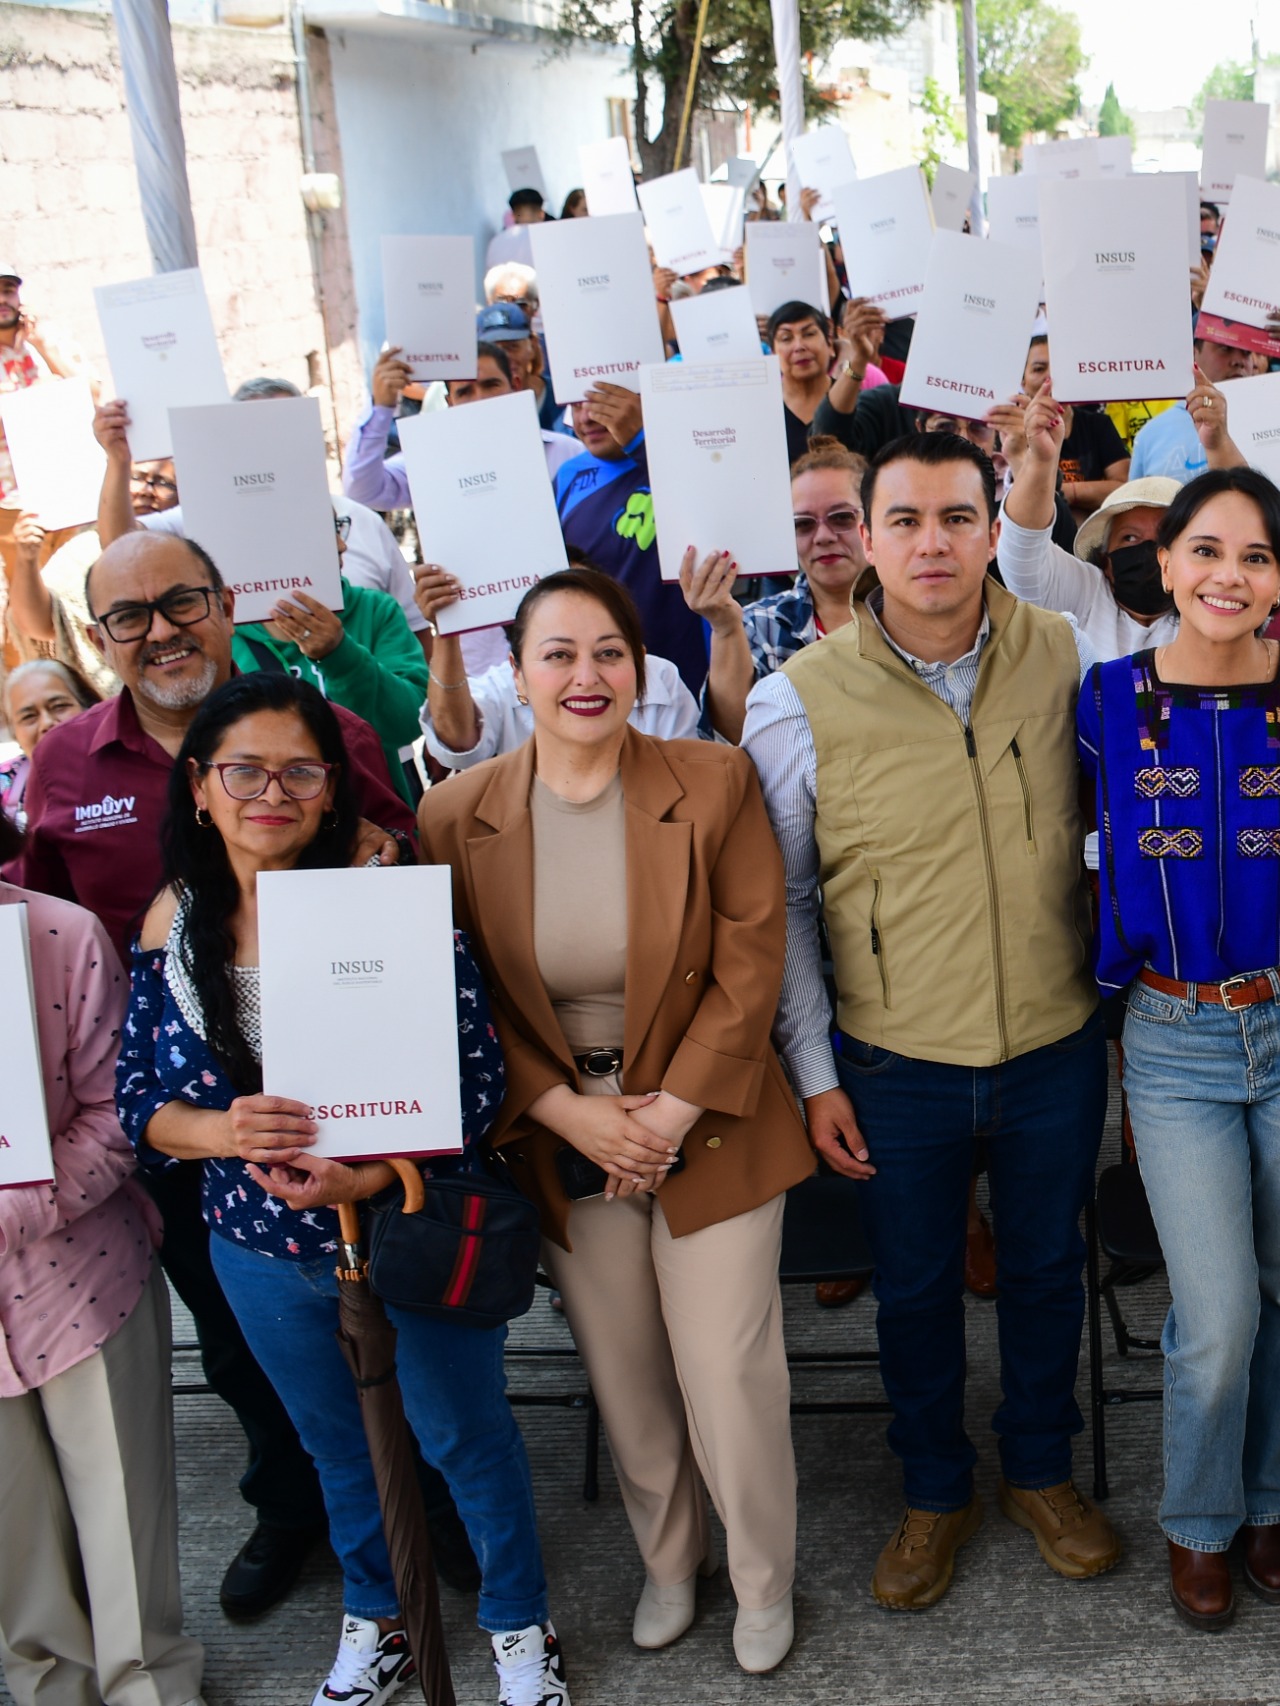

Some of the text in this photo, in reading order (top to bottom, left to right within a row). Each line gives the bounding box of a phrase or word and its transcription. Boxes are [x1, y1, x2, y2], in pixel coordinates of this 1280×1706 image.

[1095, 252, 1136, 264] INSUS
[577, 274, 611, 287] INSUS
[963, 294, 996, 309] INSUS
[406, 354, 460, 363] ESCRITURA
[1078, 359, 1166, 373] ESCRITURA
[926, 375, 995, 400] ESCRITURA
[692, 427, 736, 438] Desarrollo
[694, 436, 736, 446] Territorial
[233, 472, 276, 486] INSUS
[458, 471, 497, 489] INSUS
[232, 576, 313, 595] SCRITURA
[331, 960, 384, 974] INSUS
[505, 1633, 521, 1643] NIKE
[507, 1648, 526, 1657] AIR
